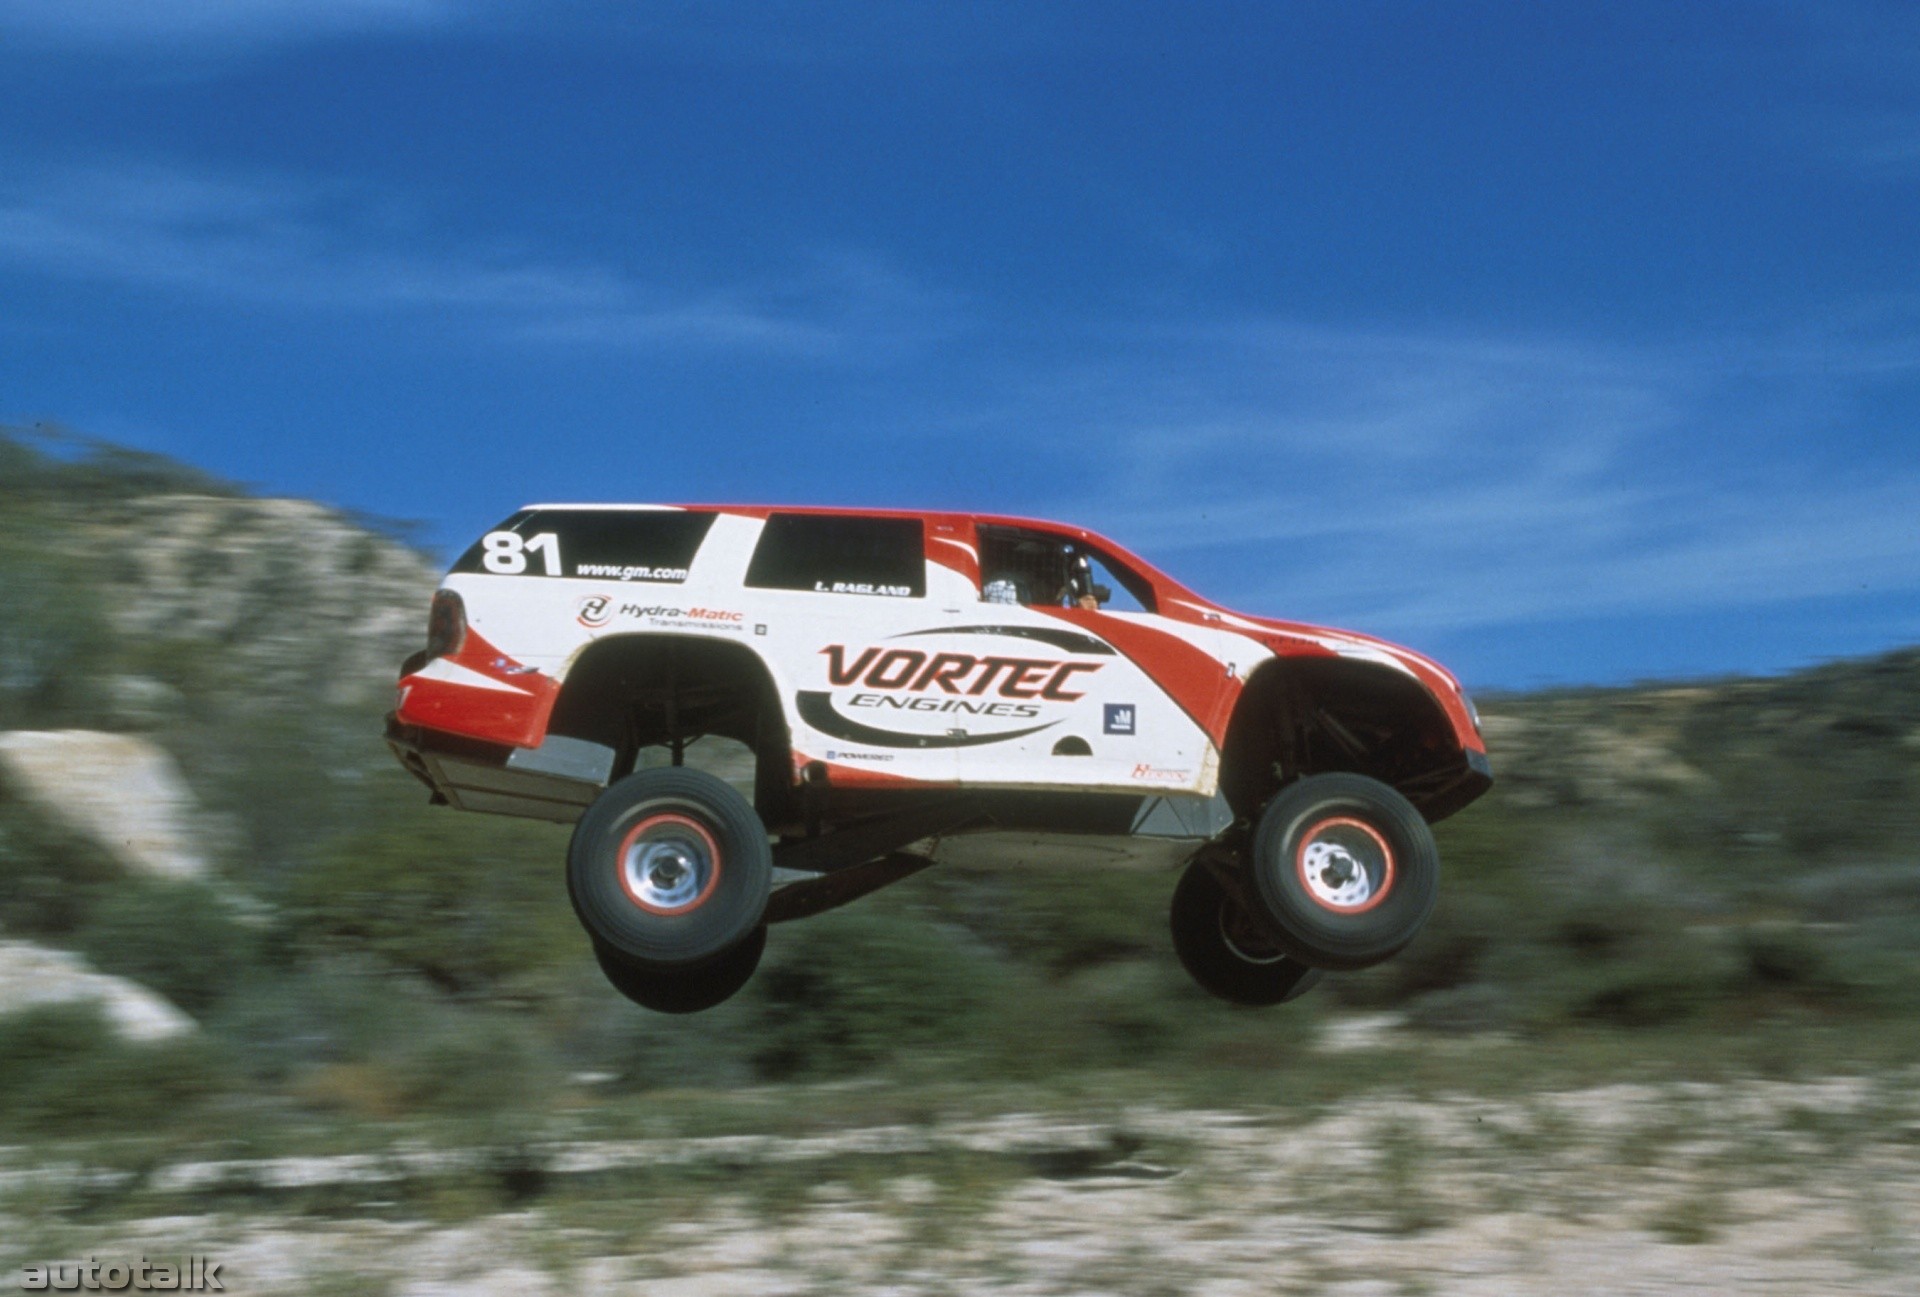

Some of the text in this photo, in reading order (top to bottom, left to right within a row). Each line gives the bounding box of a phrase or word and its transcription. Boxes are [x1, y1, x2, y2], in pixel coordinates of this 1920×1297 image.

[482, 530, 562, 576] 81
[577, 563, 689, 580] www.gm.com
[814, 581, 911, 596] L. RAGLAND
[619, 603, 744, 622] Hydra-Matic
[650, 617, 743, 632] Transmissions
[818, 644, 1105, 702] VORTEC
[848, 693, 1042, 718] ENGINES
